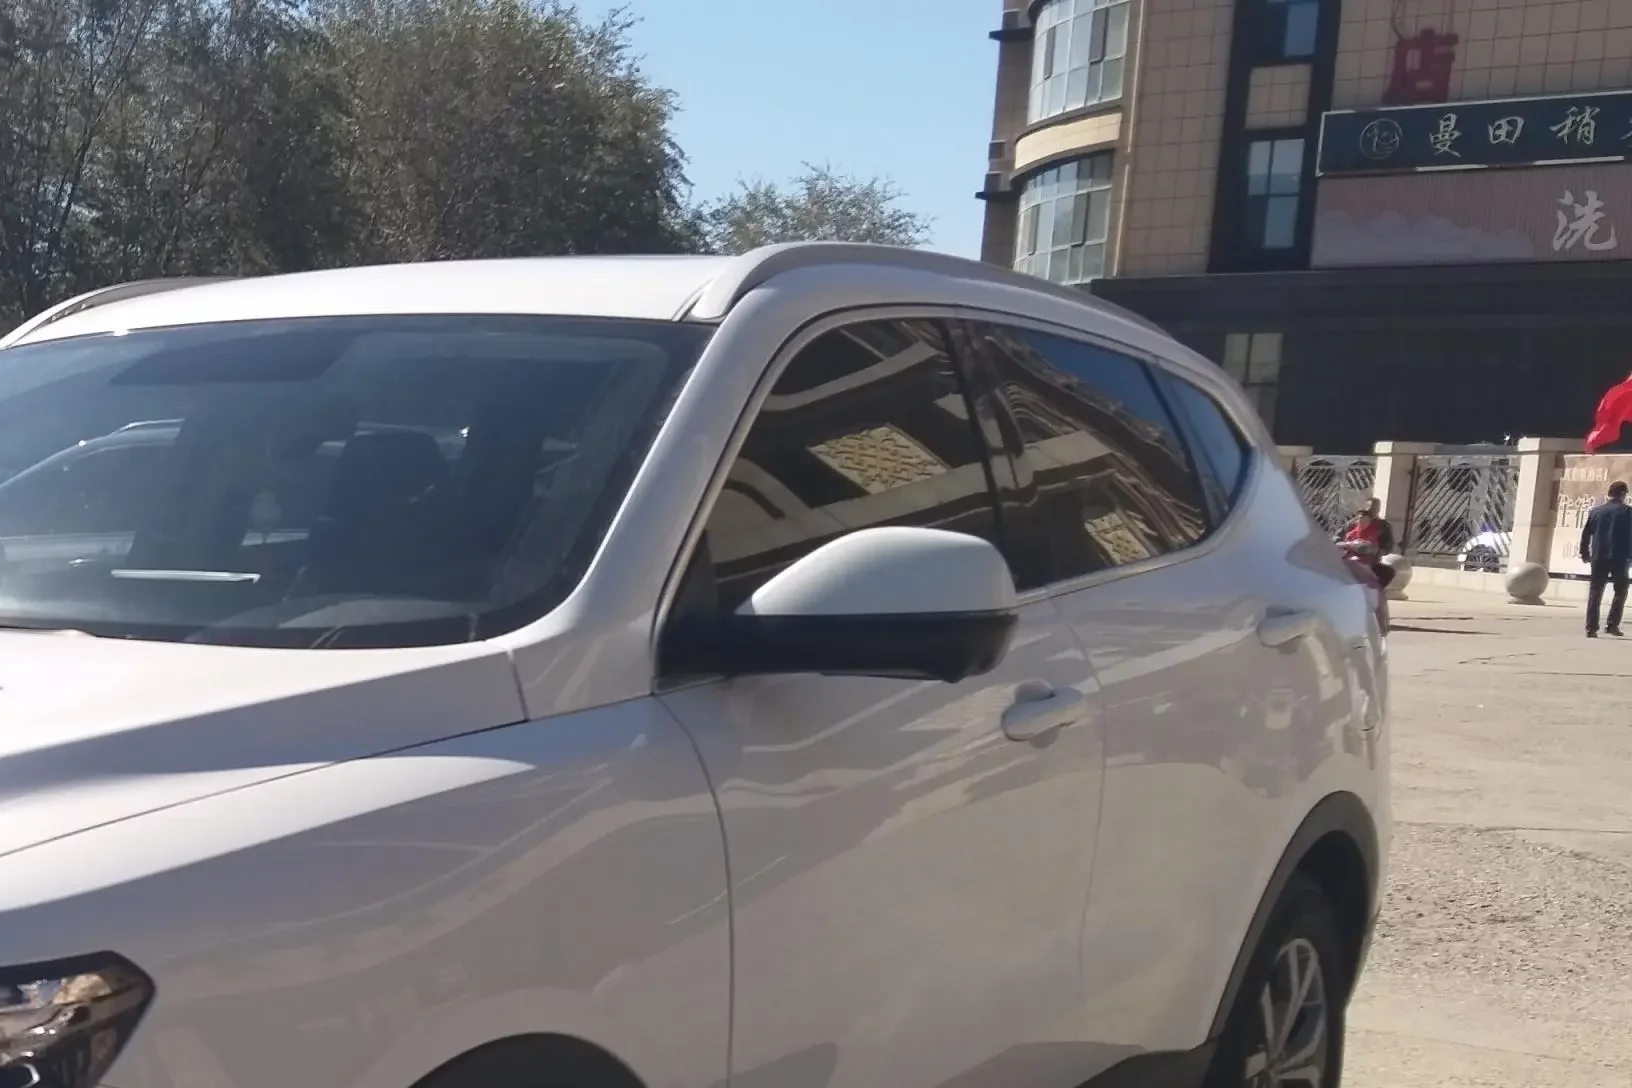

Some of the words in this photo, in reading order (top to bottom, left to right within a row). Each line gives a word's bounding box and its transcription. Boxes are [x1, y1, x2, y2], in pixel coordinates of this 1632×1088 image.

[1381, 28, 1460, 105] 店
[1429, 105, 1631, 158] 曼田稍
[1553, 190, 1617, 252] 洗
